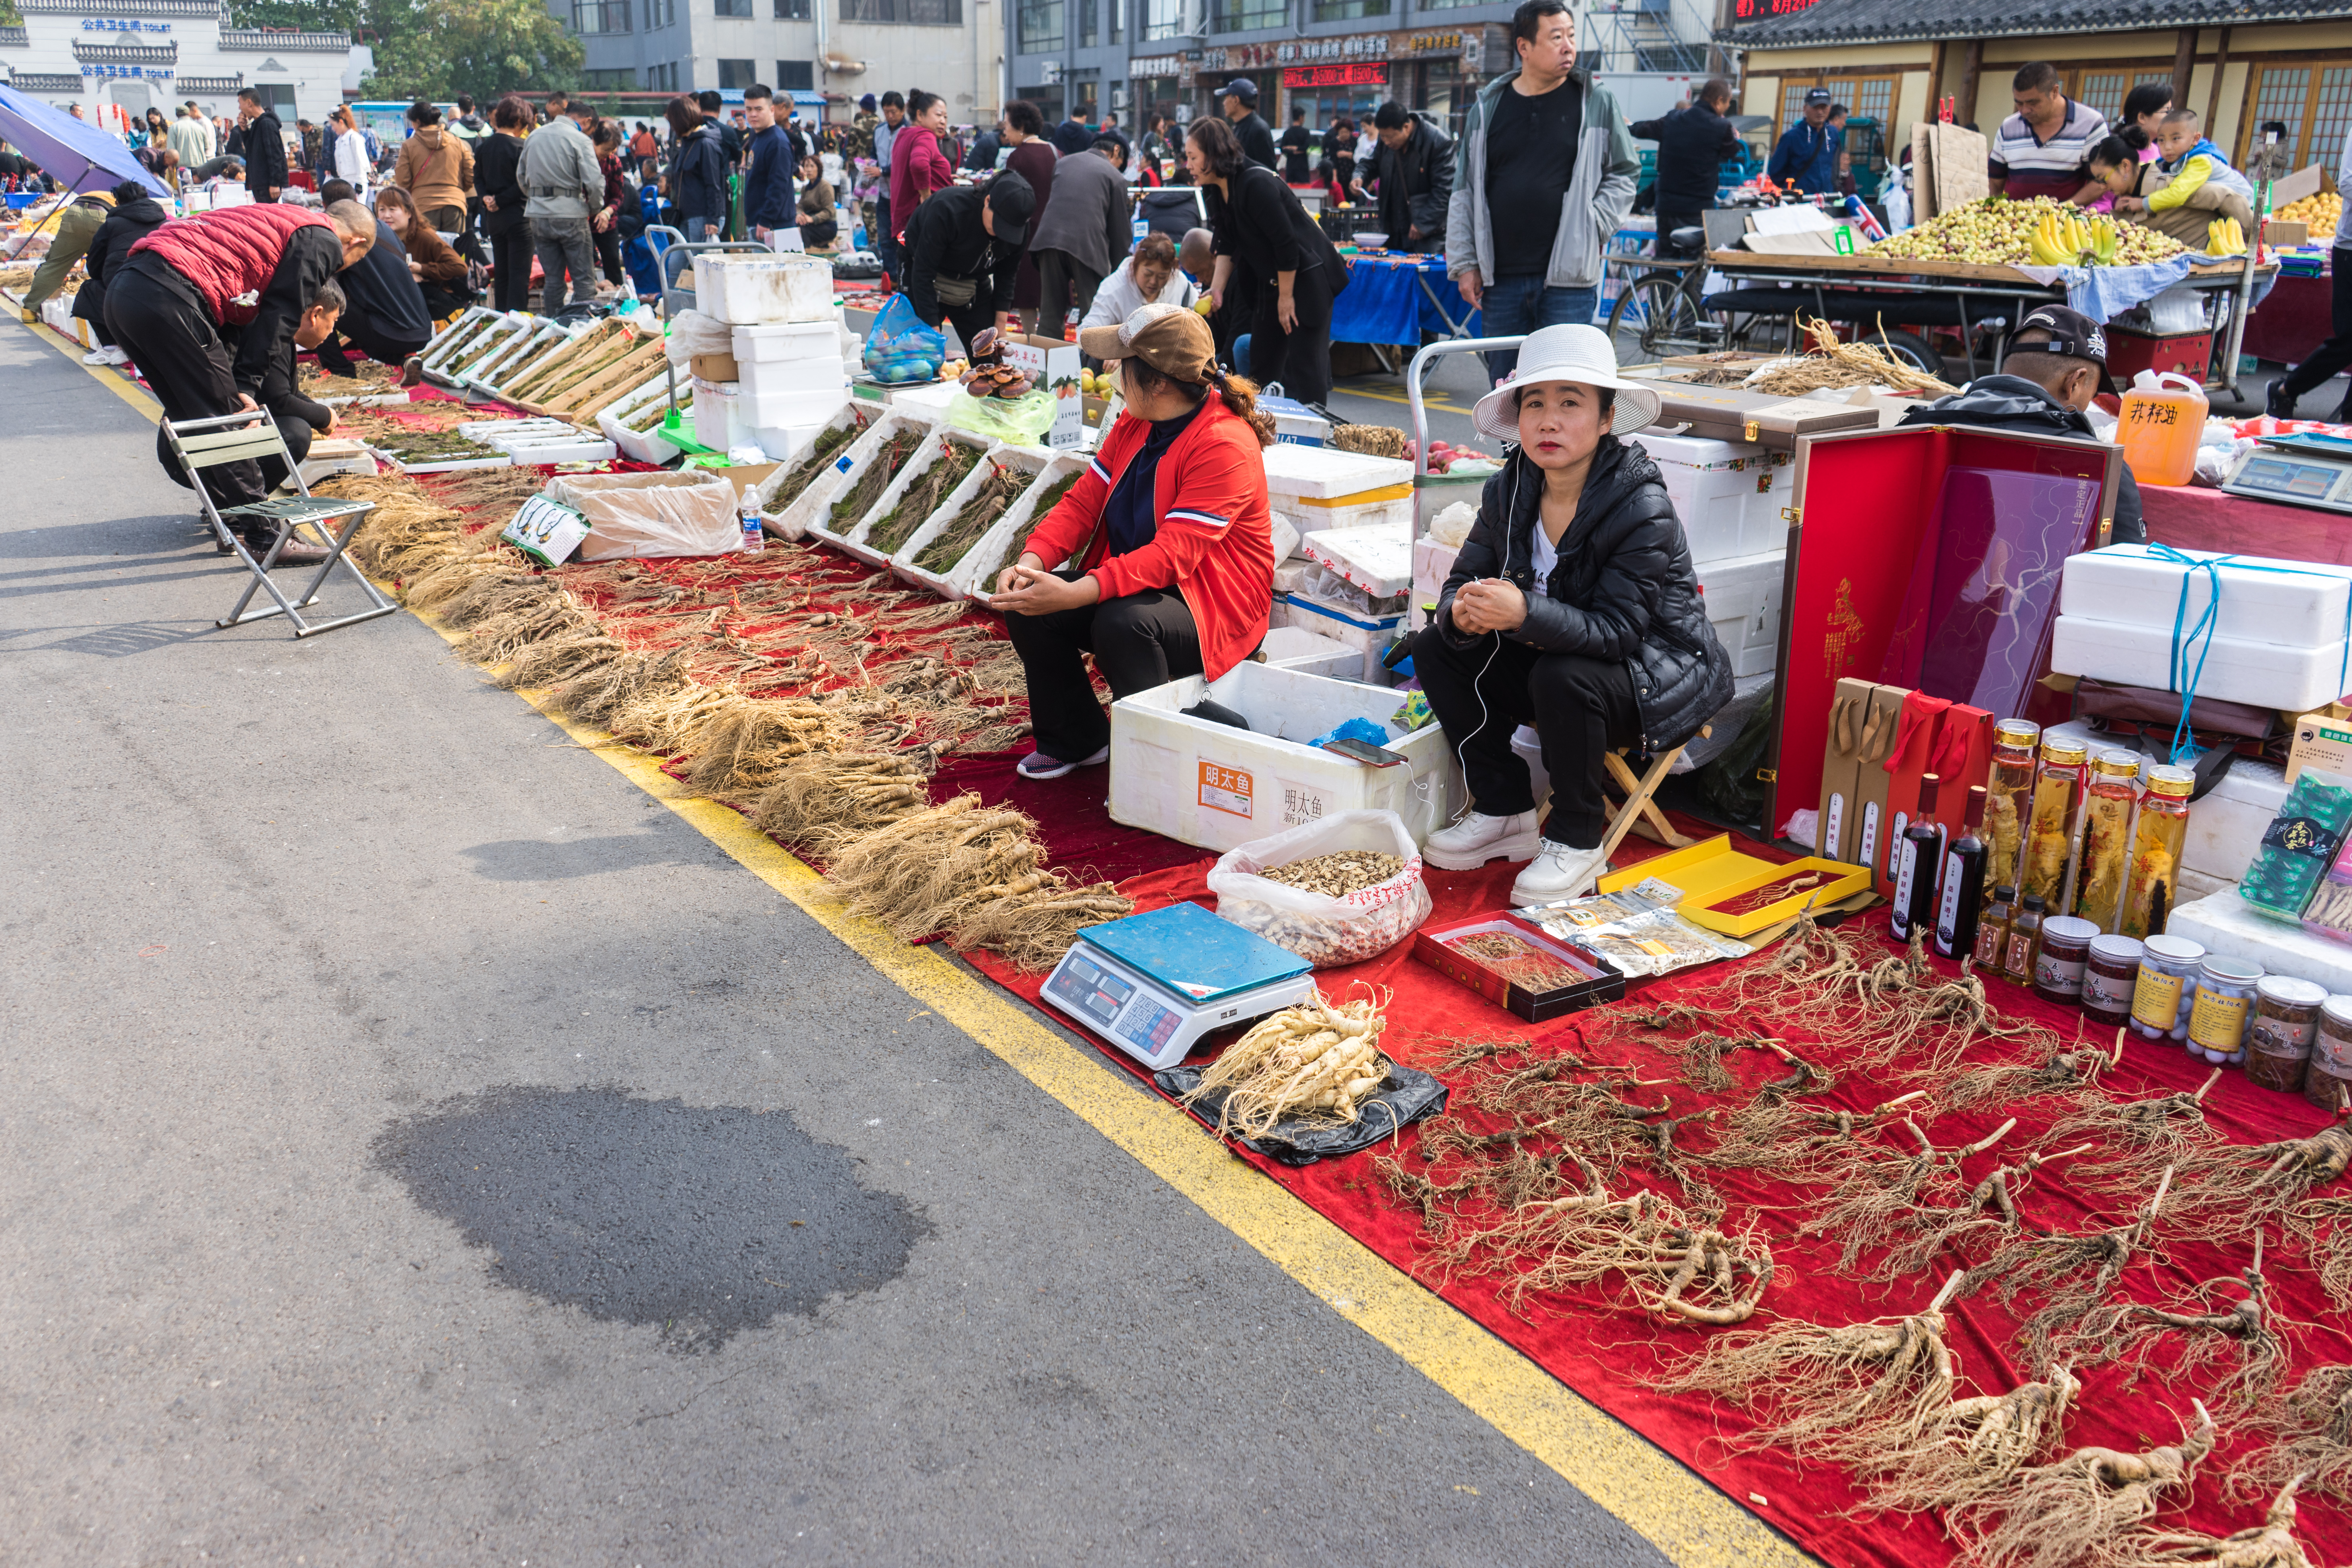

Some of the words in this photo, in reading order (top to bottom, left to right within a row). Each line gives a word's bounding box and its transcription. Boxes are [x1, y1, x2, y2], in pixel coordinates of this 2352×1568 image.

[82, 19, 140, 31] 公共卫生间
[81, 64, 142, 78] 公共卫生间
[1008, 350, 1038, 364] 色果品
[1206, 766, 1250, 794] 明太鱼
[1285, 789, 1322, 819] 明太鱼
[1283, 812, 1314, 825] 新10
[2050, 962, 2070, 989] 五味子
[2141, 969, 2176, 987] 秘方壮阳丸
[2092, 978, 2111, 1006] 五味子
[2202, 993, 2242, 1008] 秘方壮阳丸
